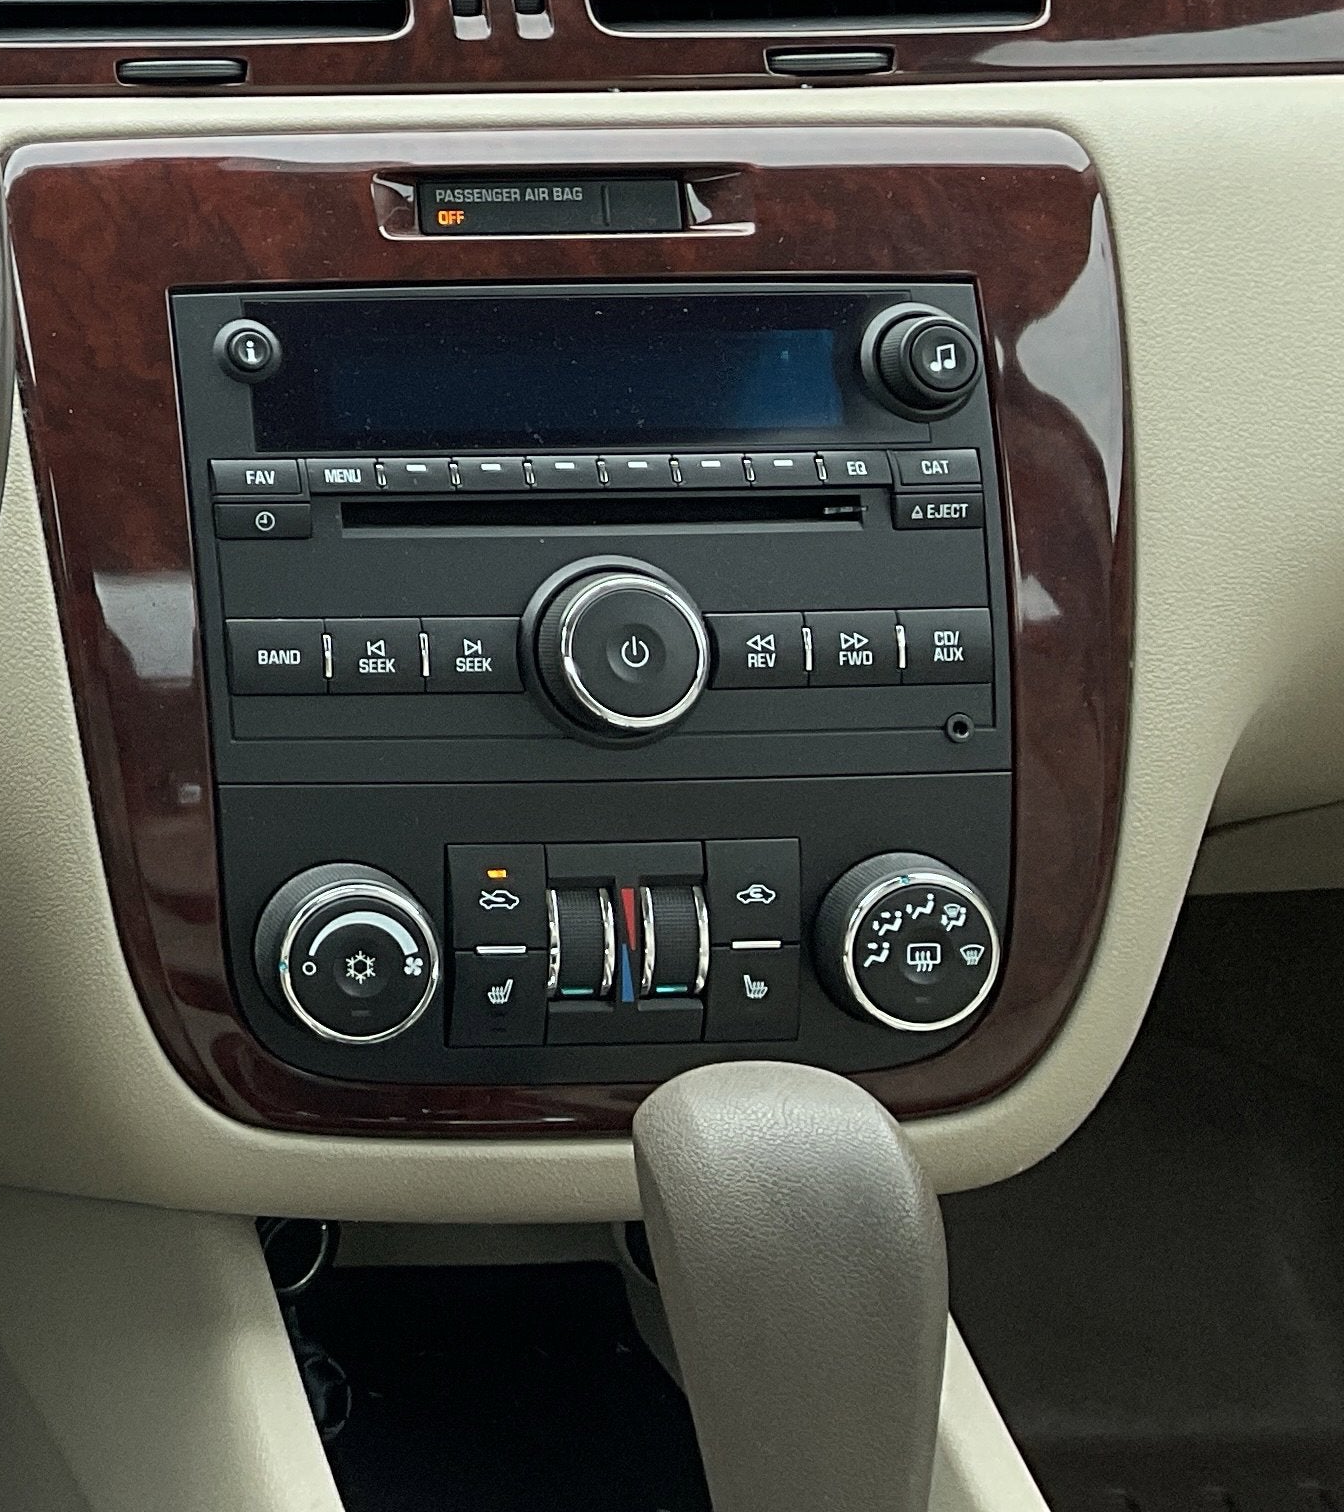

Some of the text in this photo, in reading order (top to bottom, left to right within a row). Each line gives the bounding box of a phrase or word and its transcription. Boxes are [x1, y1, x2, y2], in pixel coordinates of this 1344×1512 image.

[435, 187, 583, 203] PASSENGER AIR BAG
[437, 210, 465, 225] OFF
[846, 461, 868, 476] EQ
[921, 460, 949, 475] CAT
[245, 470, 275, 485] FAV
[323, 468, 362, 483] MENU
[926, 503, 969, 519] EJECT
[933, 630, 960, 646] CD/
[257, 649, 301, 665] BAND
[747, 653, 776, 668] REV
[838, 651, 873, 666] FWD
[933, 647, 964, 662] AUX
[358, 658, 396, 673] SEEK
[455, 657, 493, 672] SEEK
